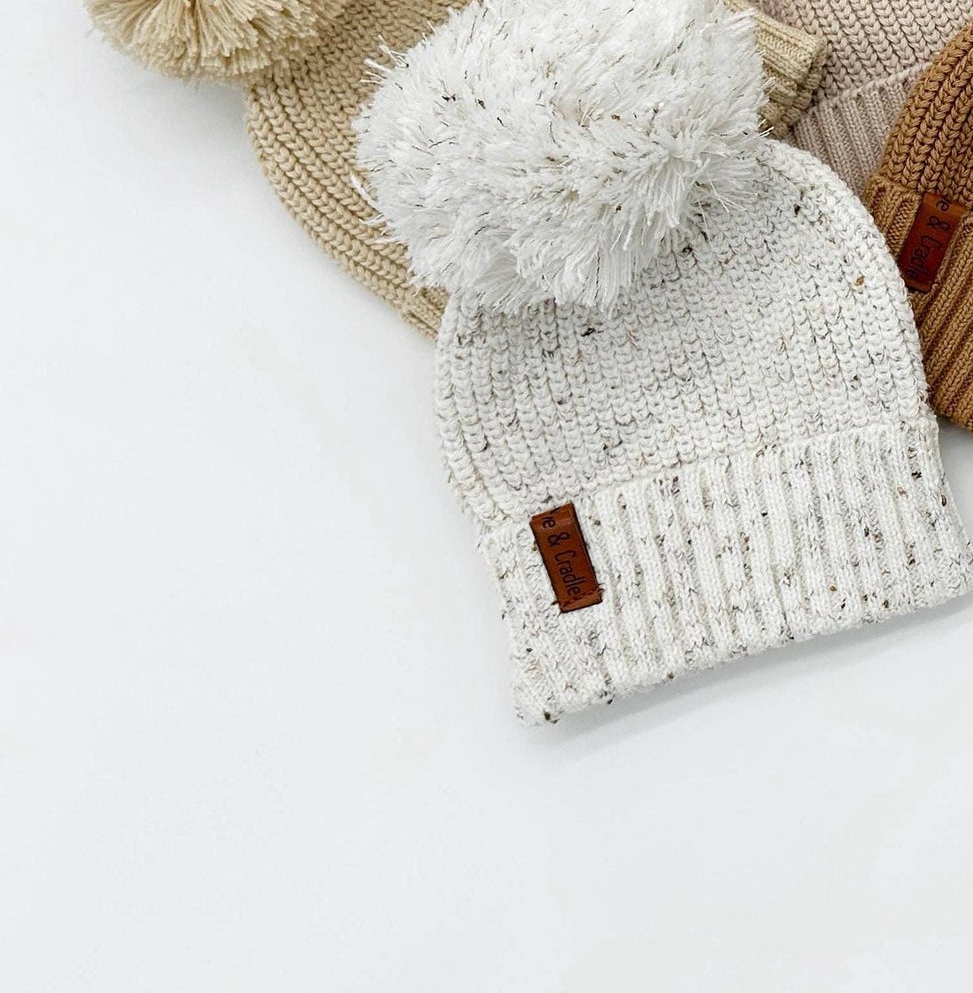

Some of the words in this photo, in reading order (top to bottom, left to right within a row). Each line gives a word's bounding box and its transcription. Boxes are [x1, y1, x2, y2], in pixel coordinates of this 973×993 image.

[926, 215, 950, 230] &
[906, 234, 942, 279] Cradle
[548, 532, 570, 547] &
[554, 550, 587, 596] Cradle
